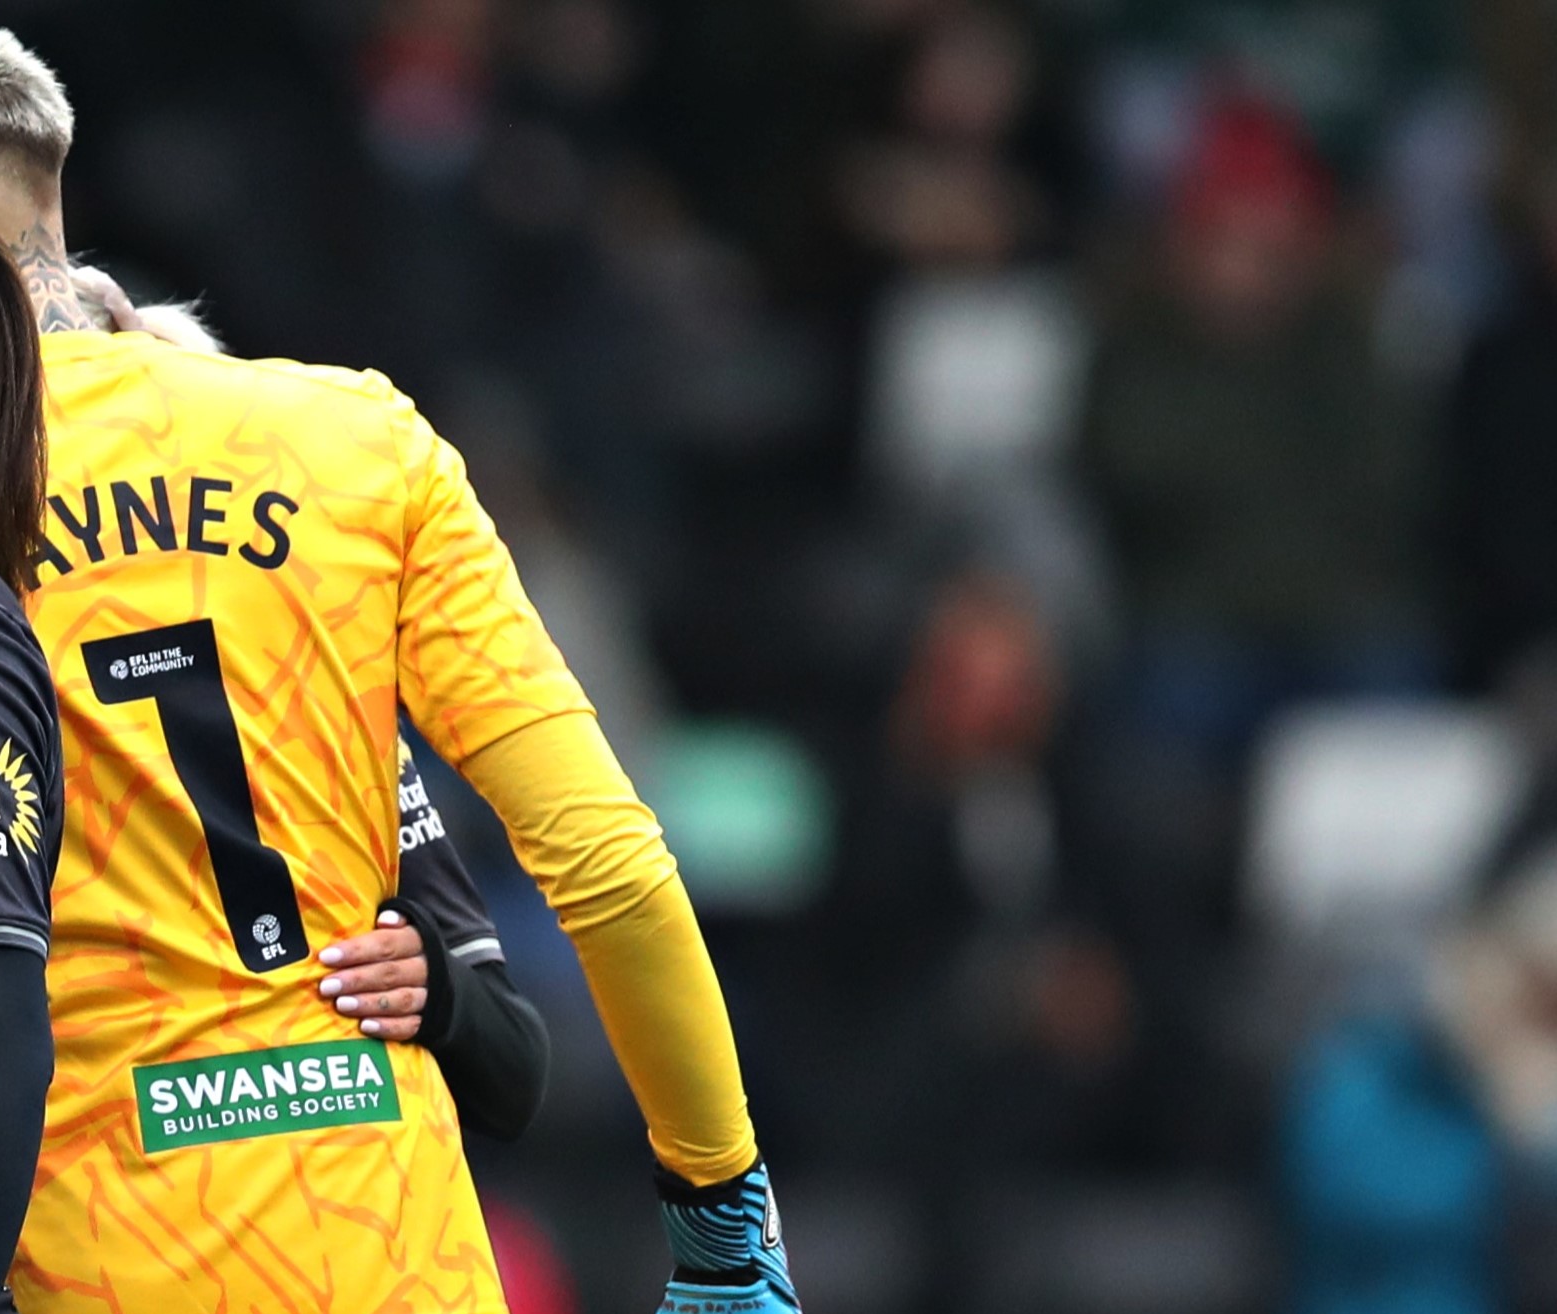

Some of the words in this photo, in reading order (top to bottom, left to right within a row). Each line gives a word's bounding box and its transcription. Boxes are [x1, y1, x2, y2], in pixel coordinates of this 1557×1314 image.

[25, 475, 300, 592] AYNES
[129, 654, 148, 667] EFL
[149, 651, 162, 663] IN
[162, 646, 183, 661] THE
[131, 655, 195, 678] COMMUNITY
[80, 617, 311, 974] 1
[262, 941, 287, 960] EFL
[148, 1053, 384, 1114] SWANSEA
[163, 1103, 280, 1136] BUILDING
[289, 1090, 381, 1119] SOCIETY
